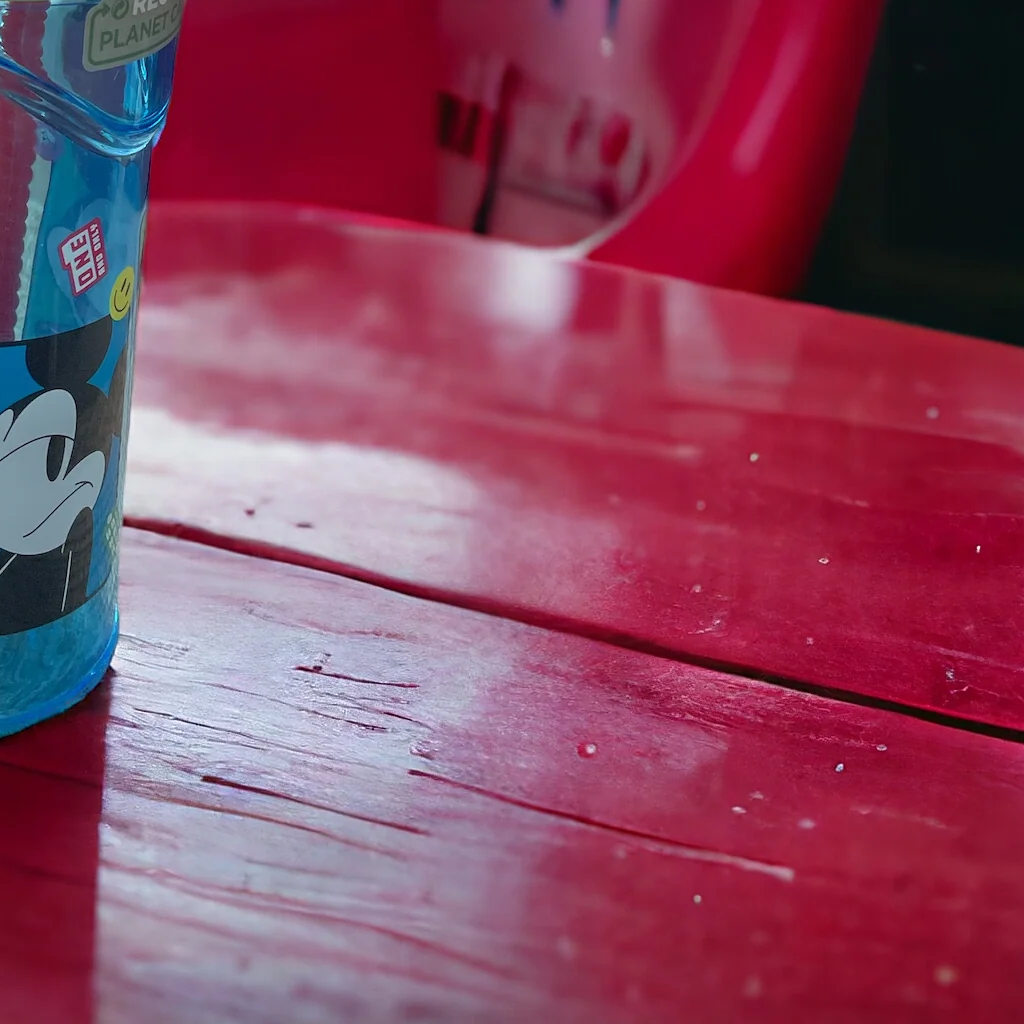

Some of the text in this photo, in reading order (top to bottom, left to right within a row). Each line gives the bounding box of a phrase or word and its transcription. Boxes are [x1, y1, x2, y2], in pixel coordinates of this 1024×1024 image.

[99, 11, 170, 52] PLANET
[90, 223, 102, 252] ONLY
[70, 234, 94, 287] ONE
